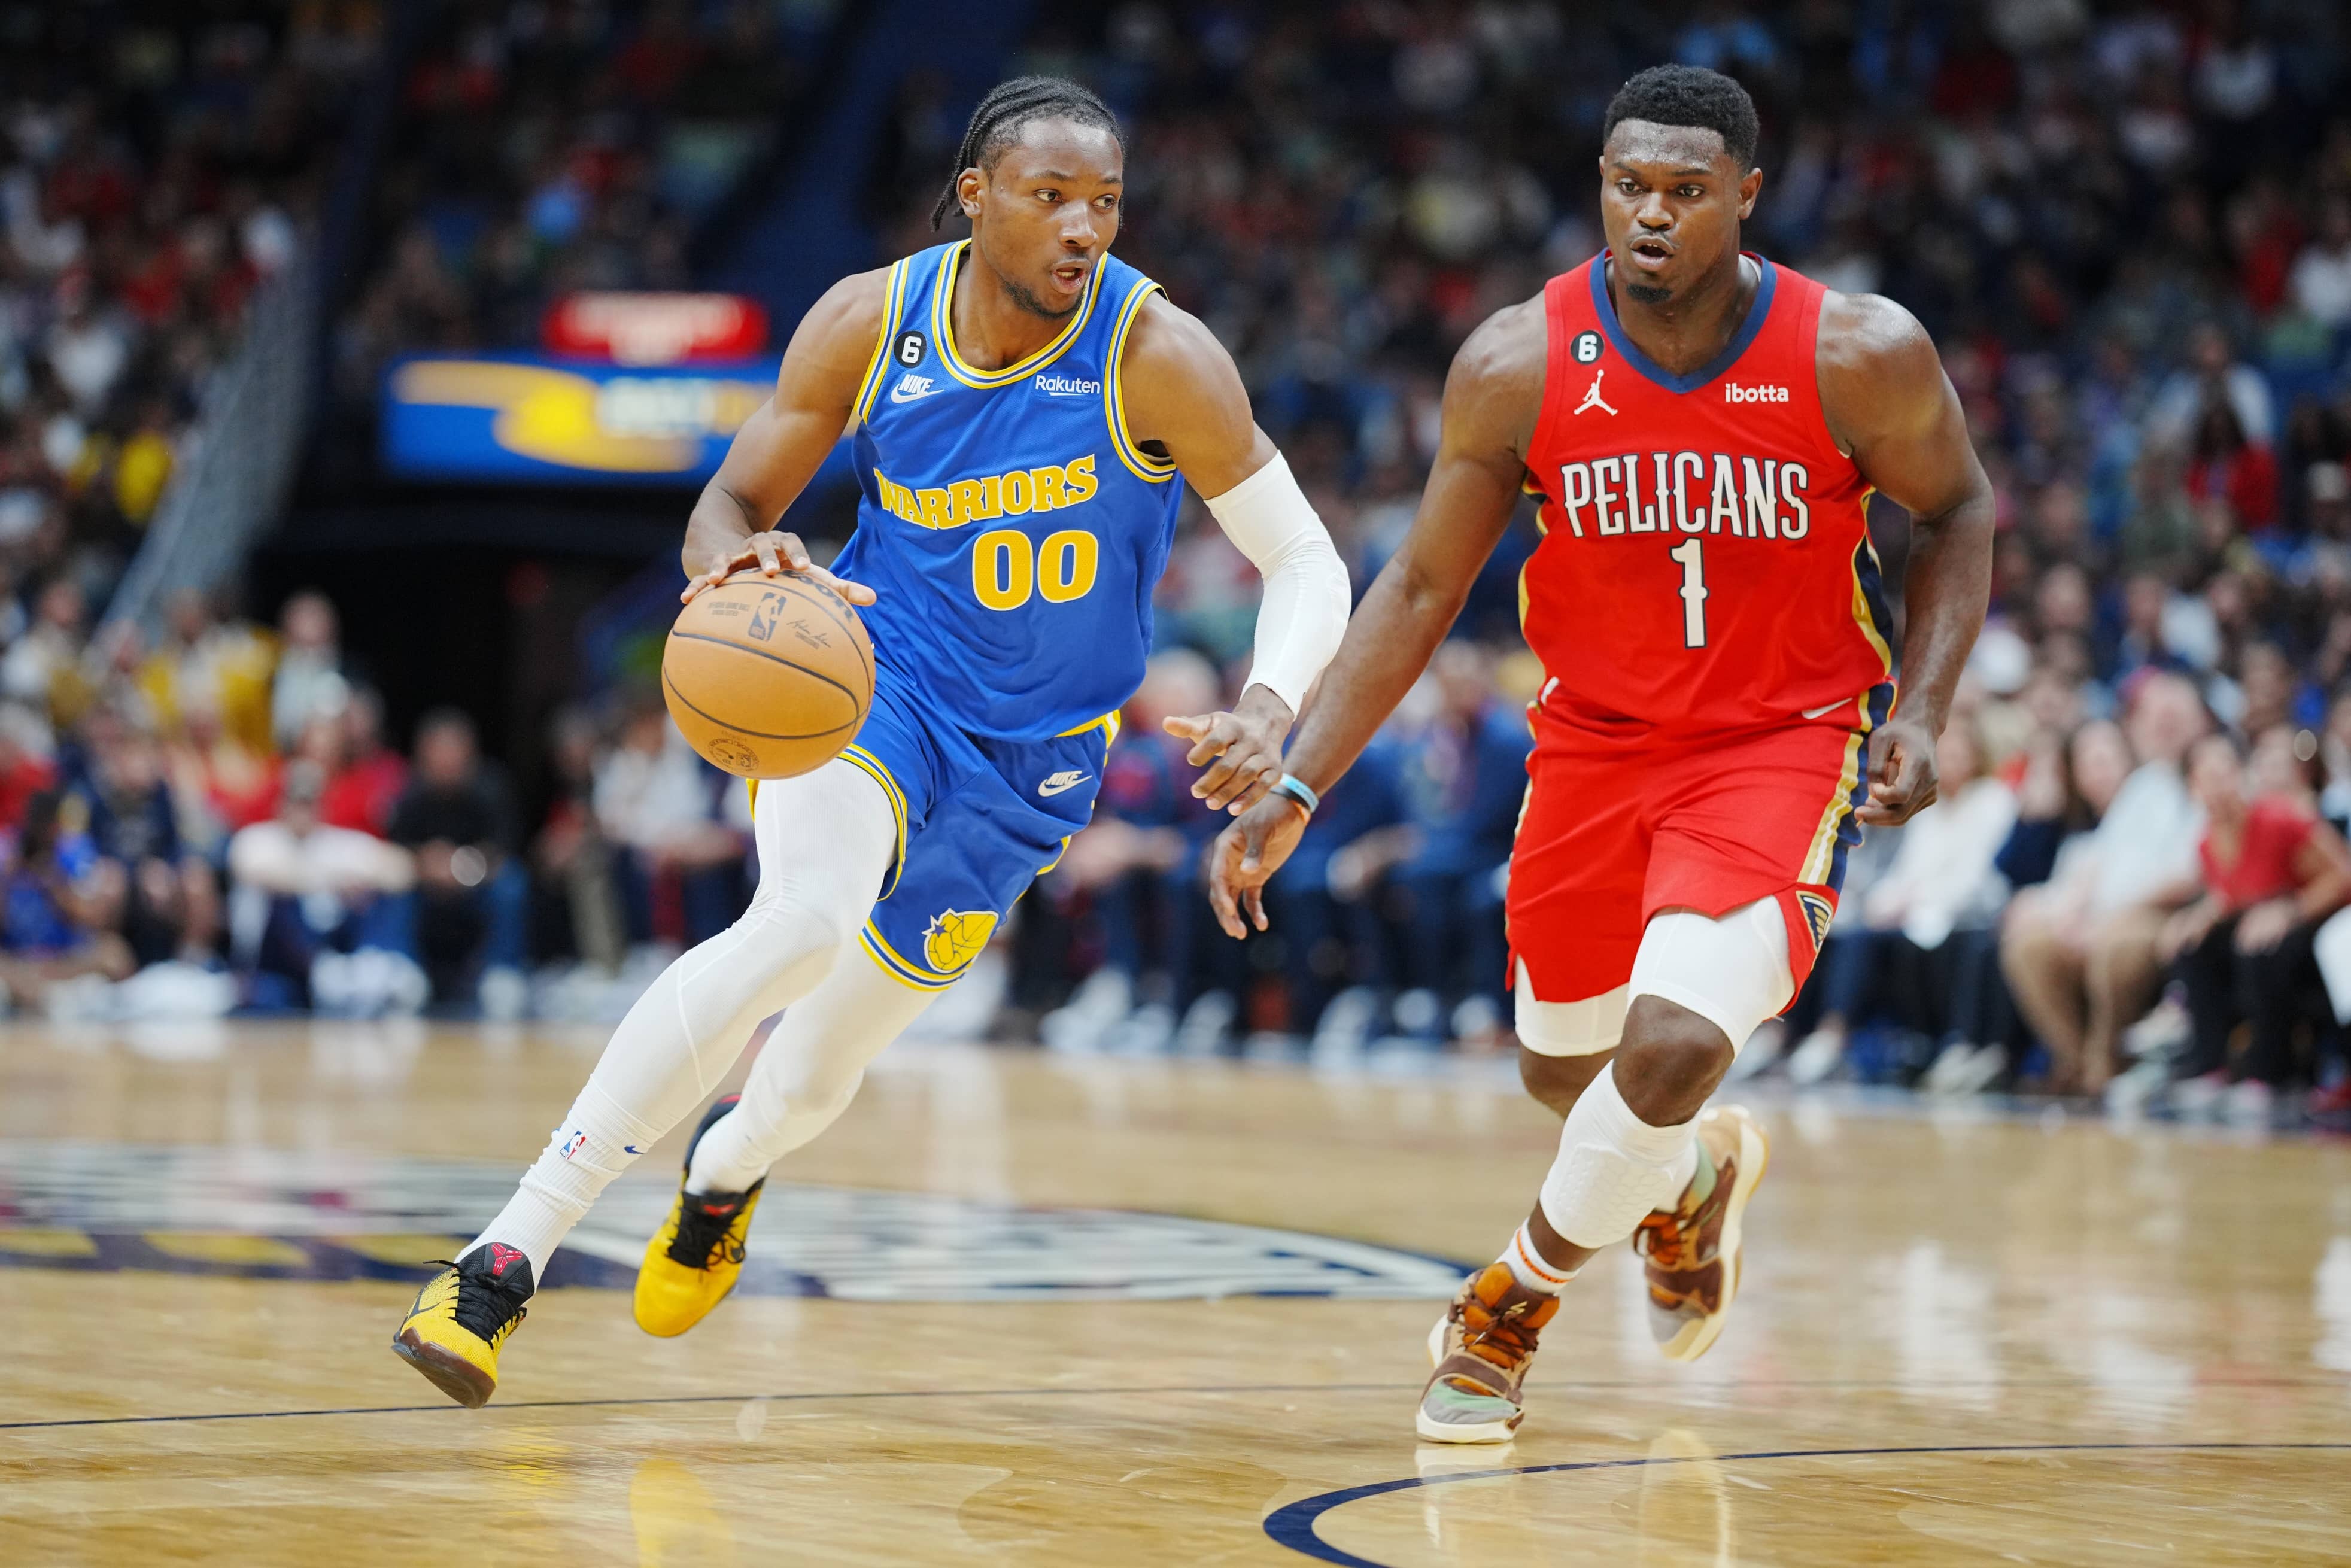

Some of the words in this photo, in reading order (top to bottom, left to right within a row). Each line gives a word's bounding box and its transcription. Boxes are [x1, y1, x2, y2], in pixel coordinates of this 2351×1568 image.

[901, 336, 922, 364] 6
[1577, 335, 1597, 361] 6
[898, 374, 934, 394] NIKE
[1035, 375, 1100, 395] Rakuten
[1725, 383, 1789, 402] ibotta
[873, 454, 1099, 531] WARRIORS
[1560, 450, 1809, 540] PELICANS
[972, 530, 1099, 611] 00
[1669, 537, 1709, 649] 1
[1045, 770, 1083, 786] NIKE
